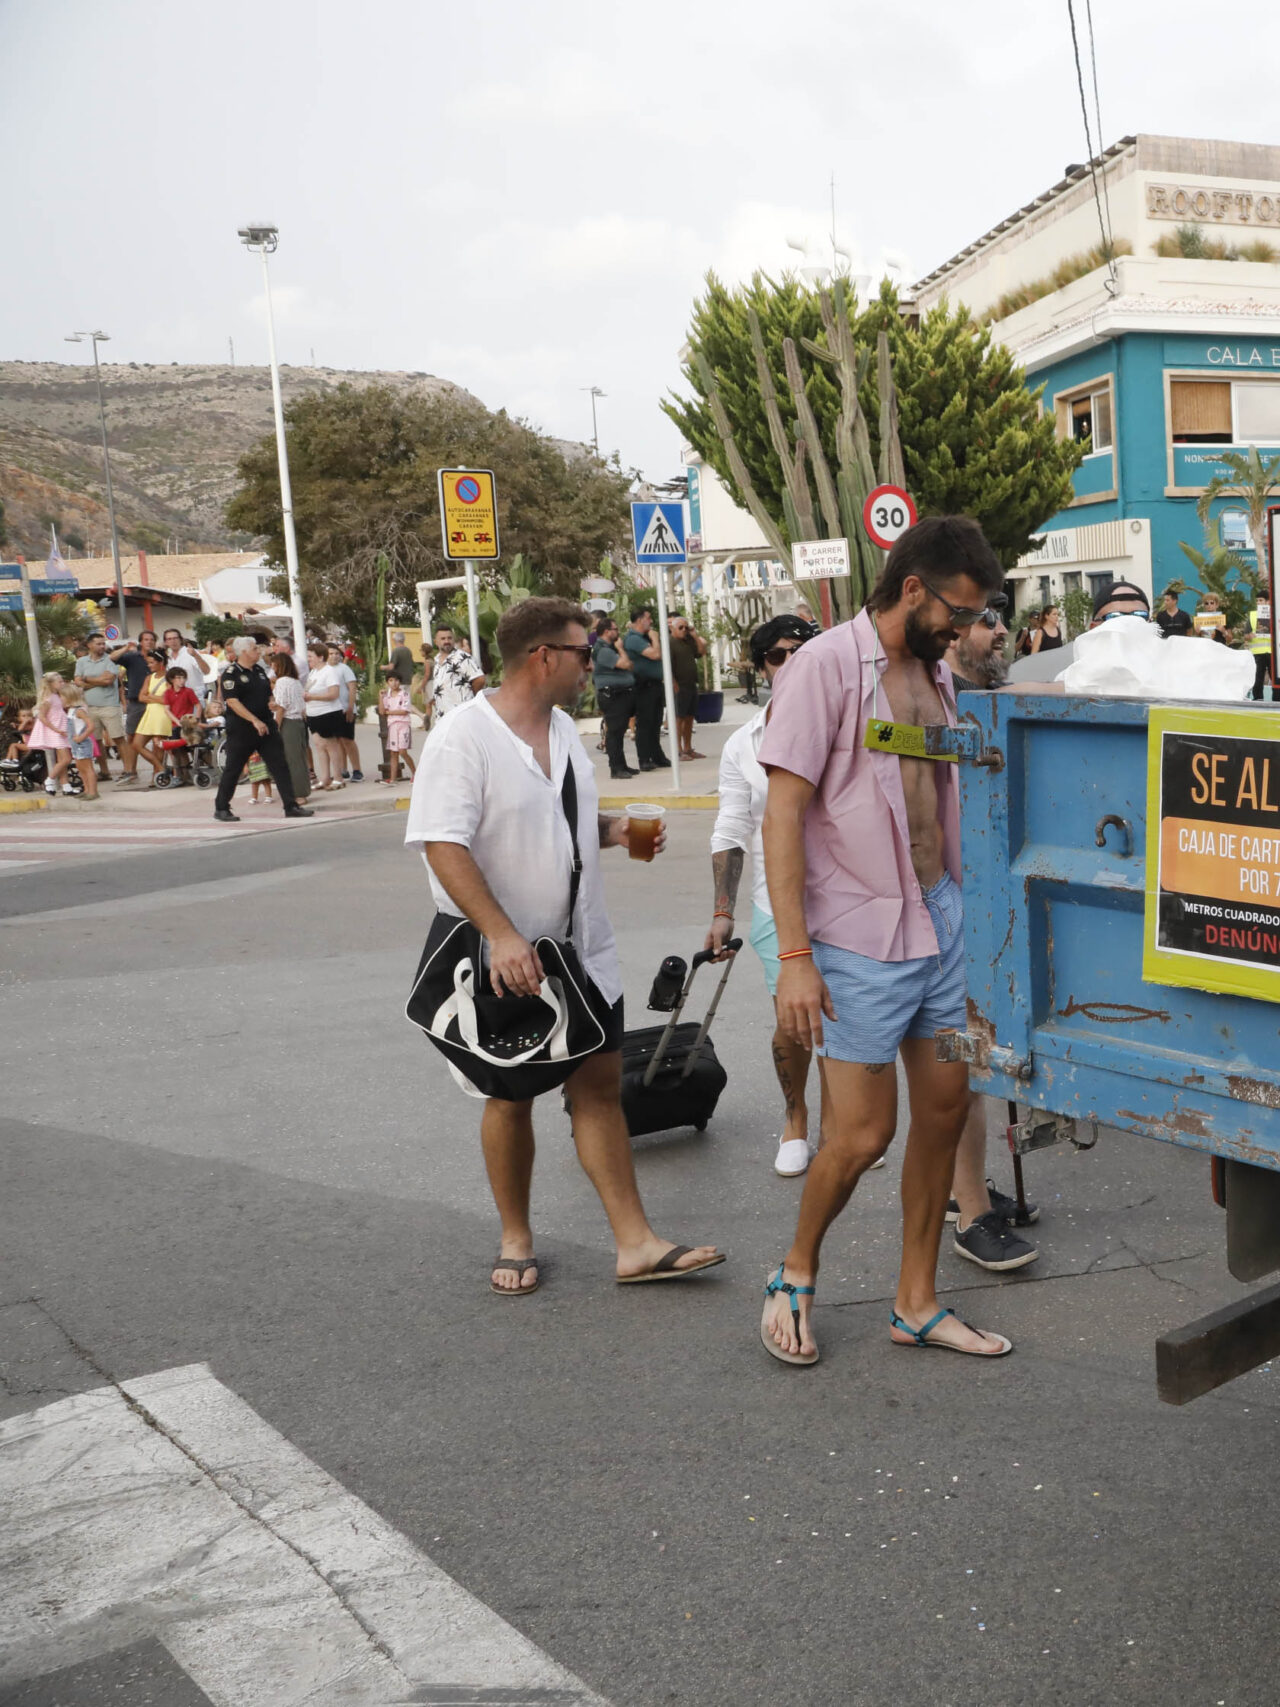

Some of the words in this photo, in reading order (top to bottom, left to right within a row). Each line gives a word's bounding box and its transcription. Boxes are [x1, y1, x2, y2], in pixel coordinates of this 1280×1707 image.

[1207, 346, 1263, 365] CALA
[875, 507, 904, 528] 30
[812, 546, 842, 556] CARRER
[827, 557, 839, 565] DE
[1190, 752, 1228, 806] SE
[1179, 828, 1216, 856] CAJA
[1219, 833, 1236, 860] DE
[1240, 867, 1270, 896] POR
[1184, 902, 1223, 918] METROS
